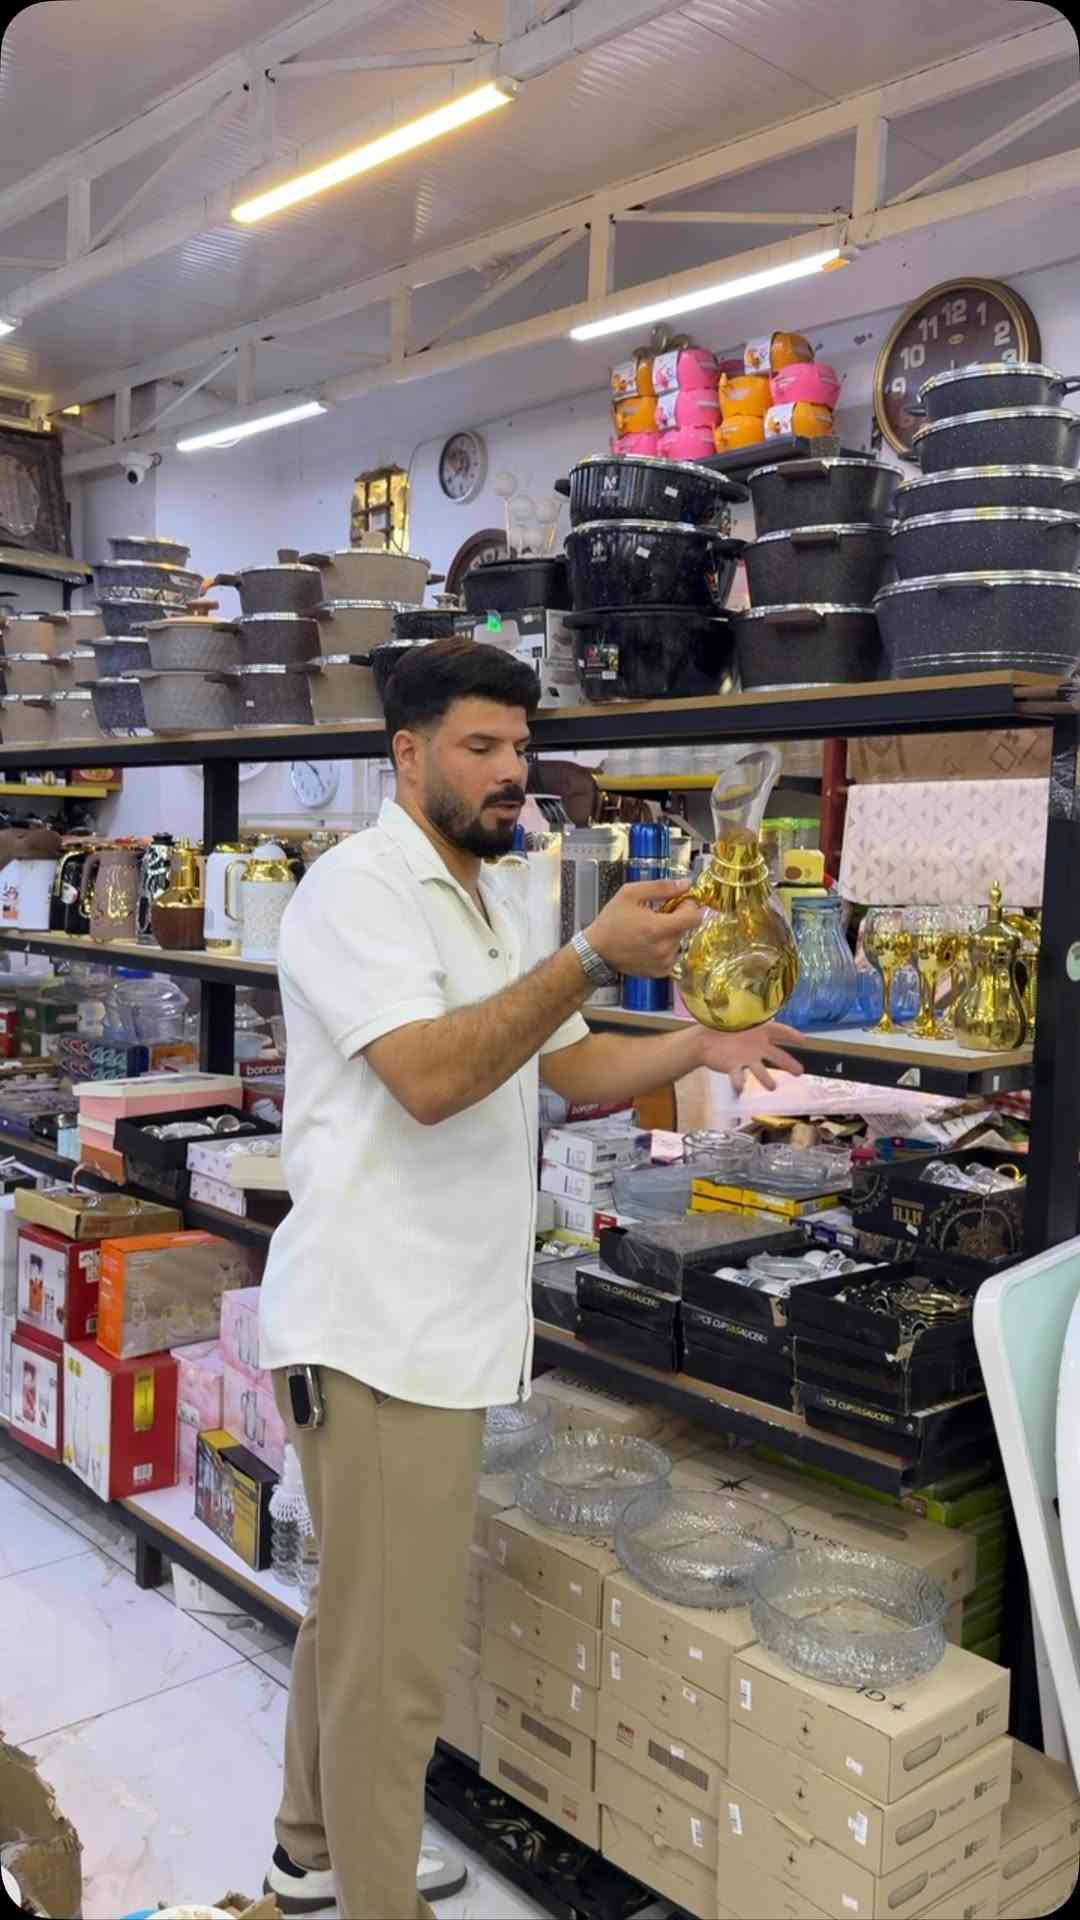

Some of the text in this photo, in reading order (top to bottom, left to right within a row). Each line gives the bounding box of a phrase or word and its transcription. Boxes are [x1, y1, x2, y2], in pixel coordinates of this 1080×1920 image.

[942, 299, 967, 325] 12
[976, 302, 987, 326] 1
[918, 316, 939, 341] 11
[994, 320, 1011, 346] 2
[900, 344, 925, 370] 10
[891, 377, 906, 396] 9
